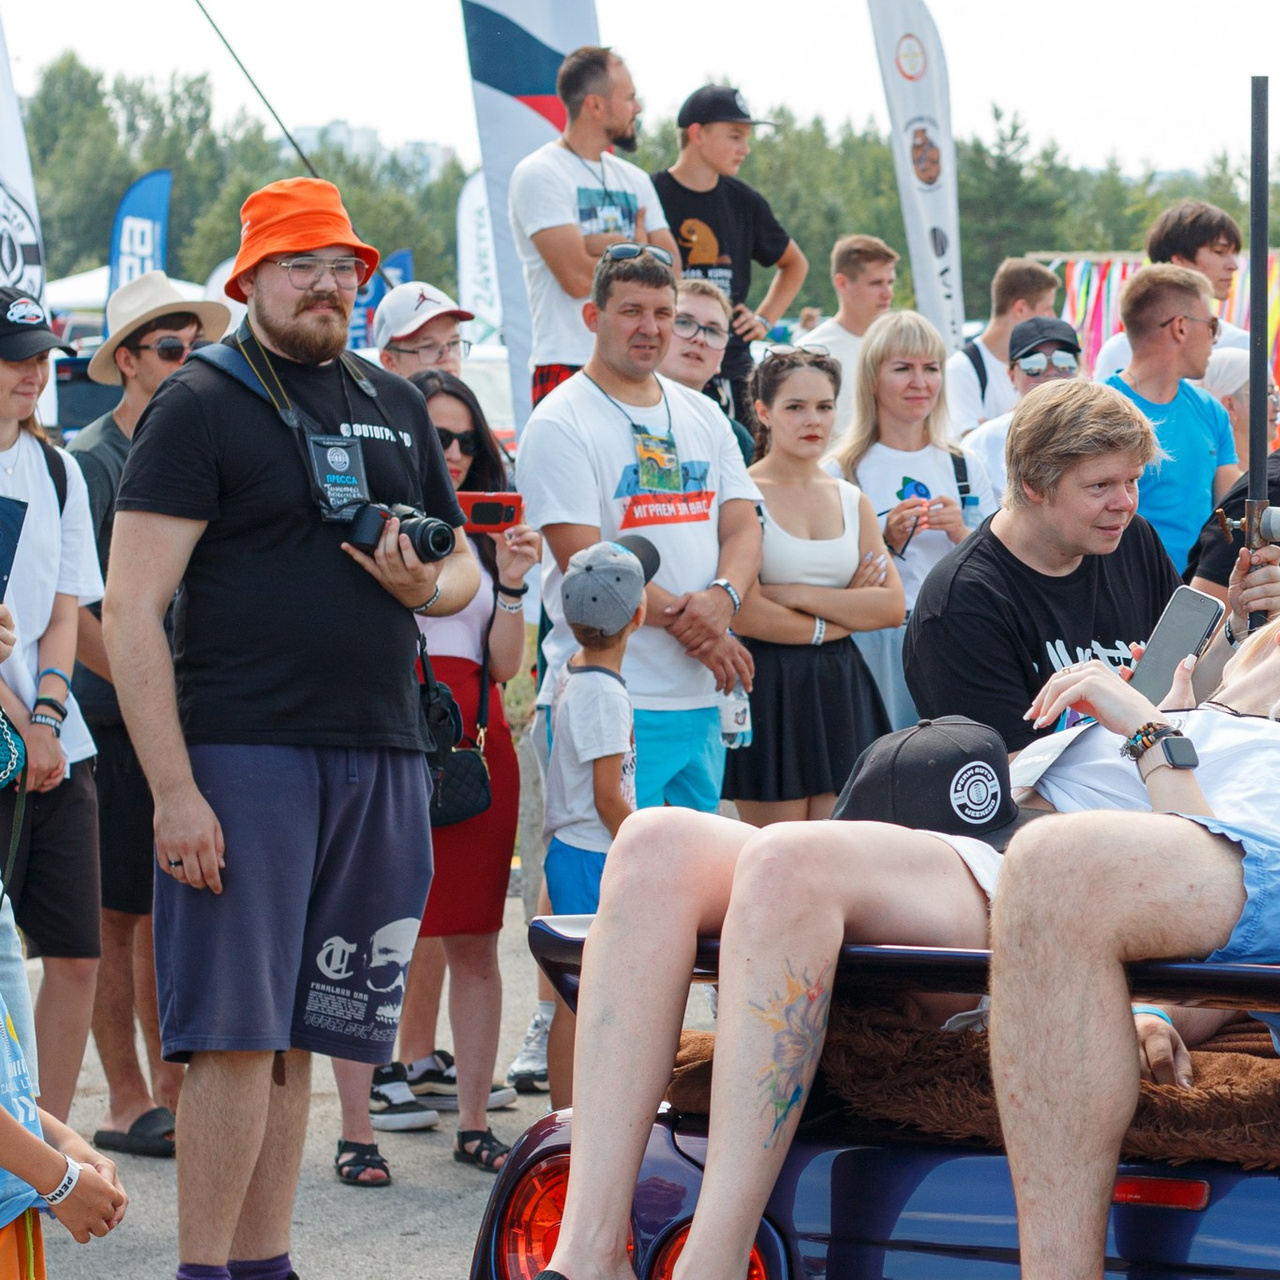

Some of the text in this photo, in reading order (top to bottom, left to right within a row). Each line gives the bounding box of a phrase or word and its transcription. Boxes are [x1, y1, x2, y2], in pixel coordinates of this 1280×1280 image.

[326, 474, 358, 485] ПРЕССА
[974, 767, 994, 781] AUTO
[964, 799, 996, 818] WEEKEND
